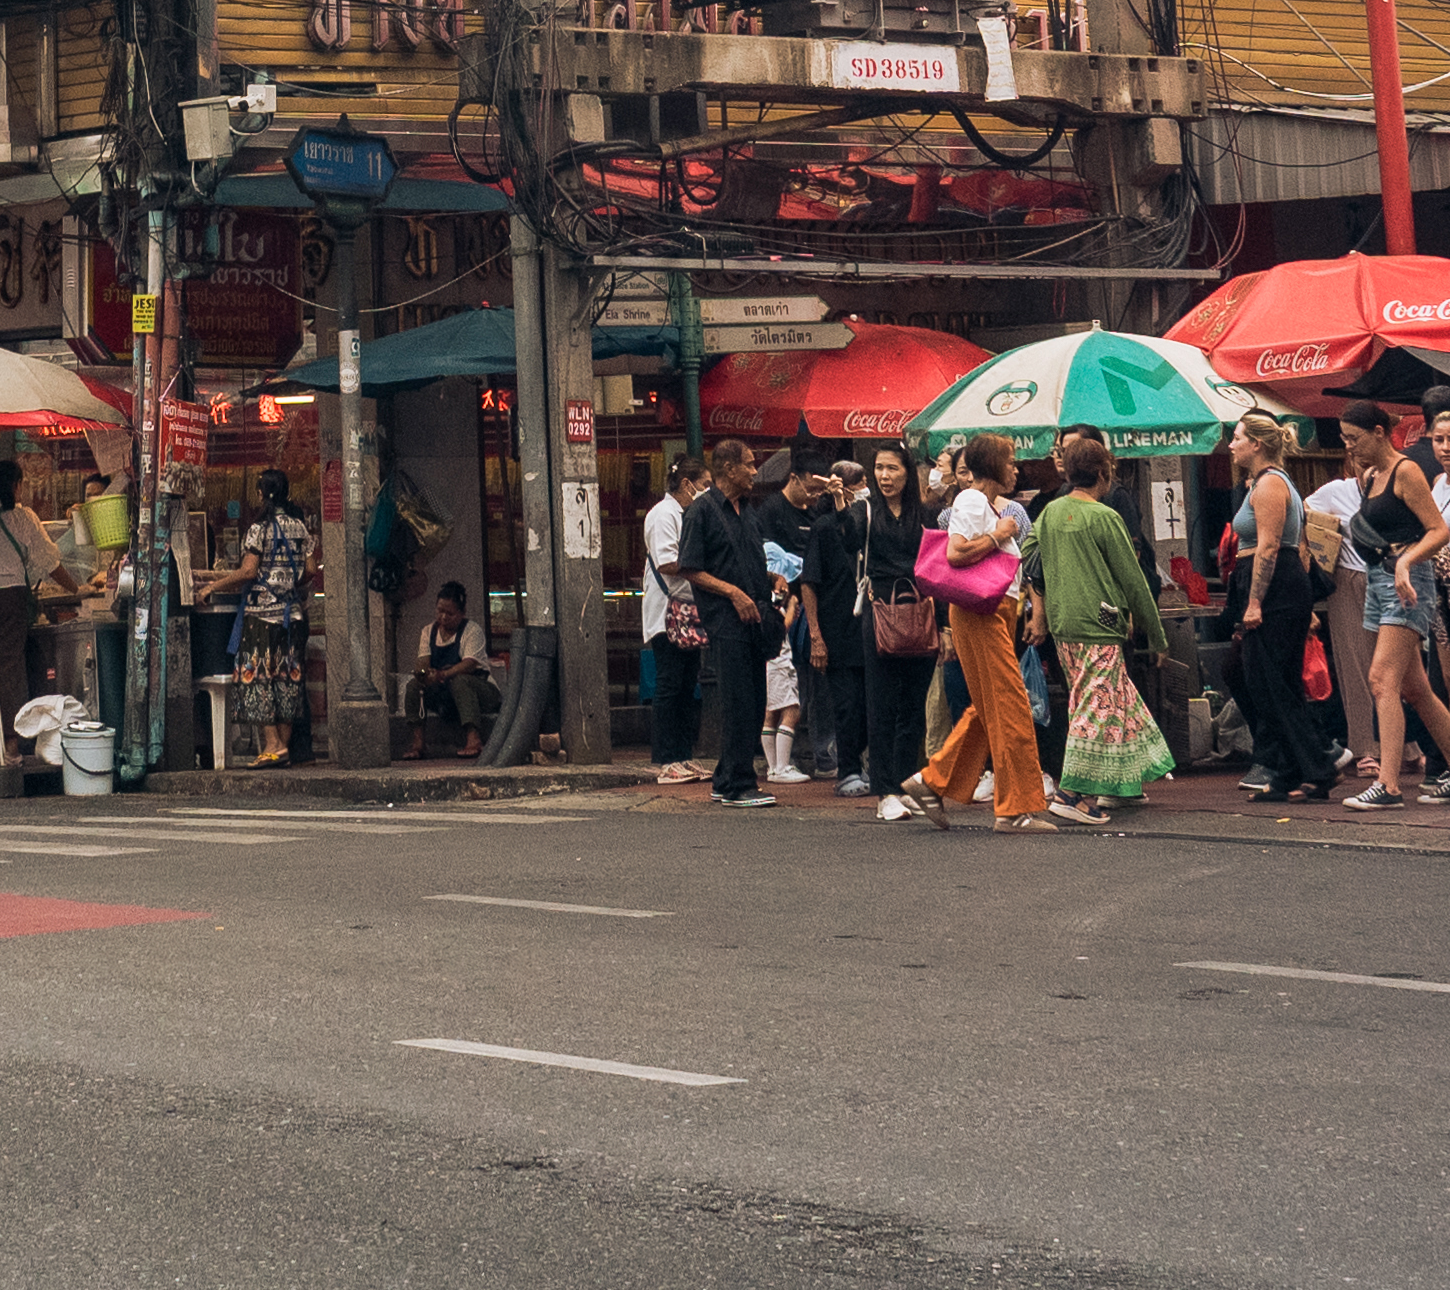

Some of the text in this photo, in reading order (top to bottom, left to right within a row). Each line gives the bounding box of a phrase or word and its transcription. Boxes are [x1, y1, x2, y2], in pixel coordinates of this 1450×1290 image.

[304, 141, 383, 180] เยาวราช 11
[623, 308, 652, 321] Shrine
[743, 302, 790, 318] ตลาดเก่า
[750, 327, 814, 347] วัดไตรมิตร
[1255, 342, 1331, 377] Coca-Cola
[568, 406, 590, 420] WLN
[568, 421, 590, 435] 0292
